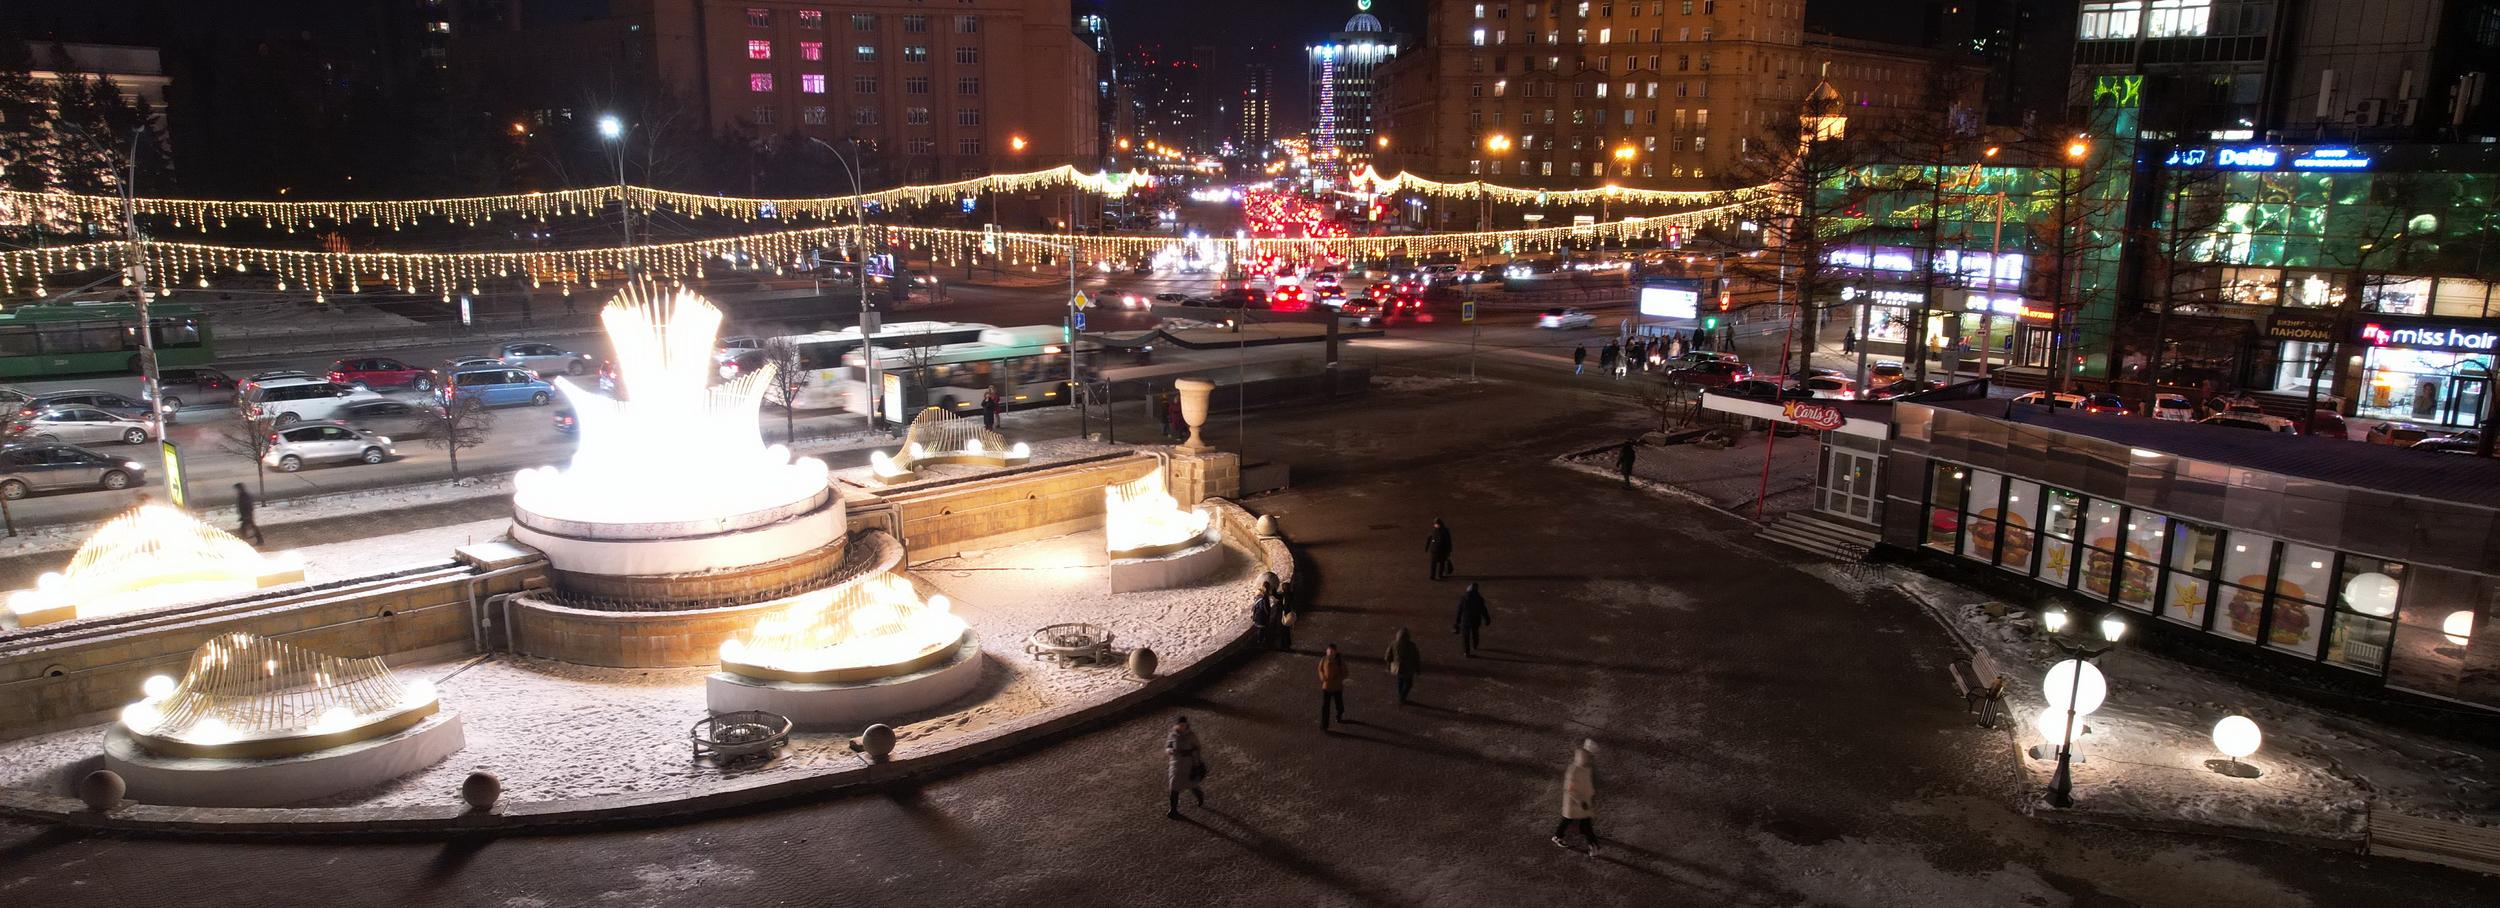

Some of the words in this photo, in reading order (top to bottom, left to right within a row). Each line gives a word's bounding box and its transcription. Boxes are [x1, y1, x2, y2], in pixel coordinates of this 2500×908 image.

[2393, 328, 2444, 346] miss
[2449, 328, 2497, 349] hair
[1794, 404, 1824, 421] Carl's
